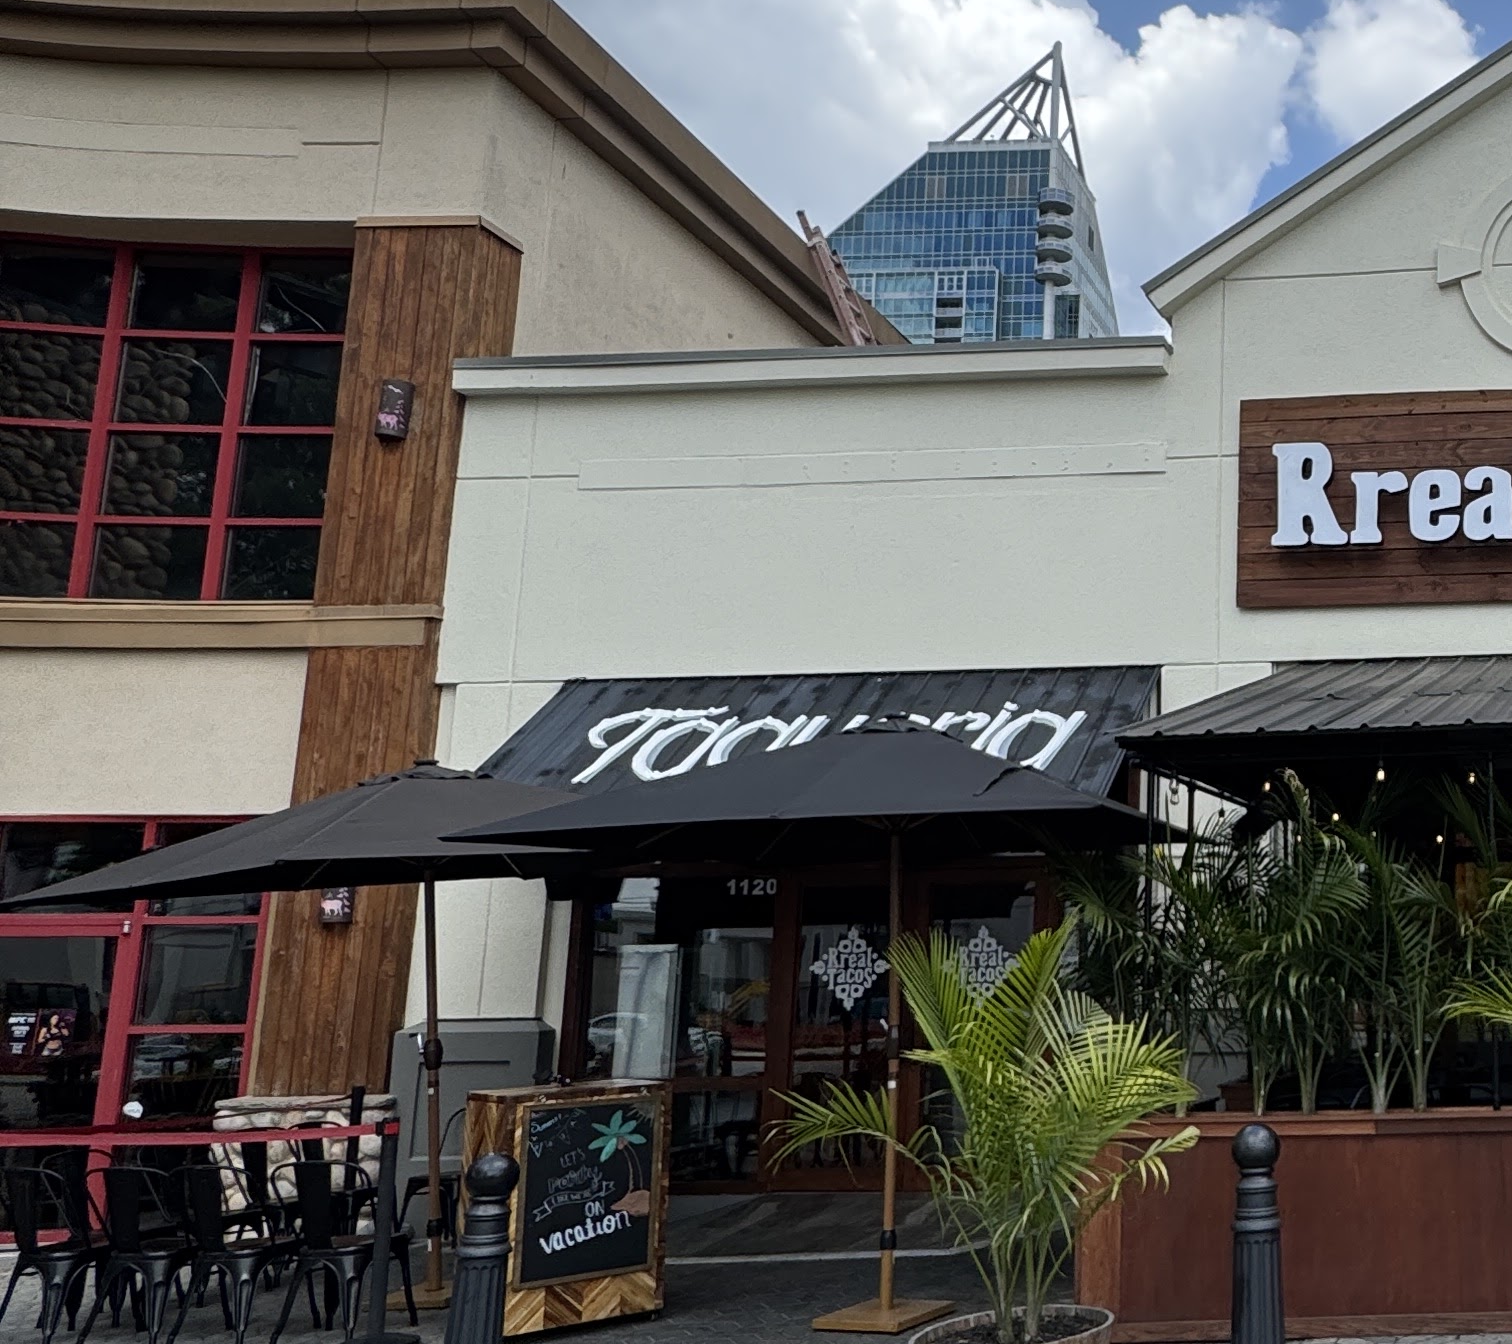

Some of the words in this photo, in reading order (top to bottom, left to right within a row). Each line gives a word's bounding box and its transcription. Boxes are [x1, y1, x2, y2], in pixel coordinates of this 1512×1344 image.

[571, 701, 1087, 783] Taqria
[726, 878, 778, 896] 1120
[827, 946, 873, 968] Rreal
[959, 944, 1004, 968] Rreal
[827, 966, 873, 991] Tacos
[585, 1199, 605, 1219] ON
